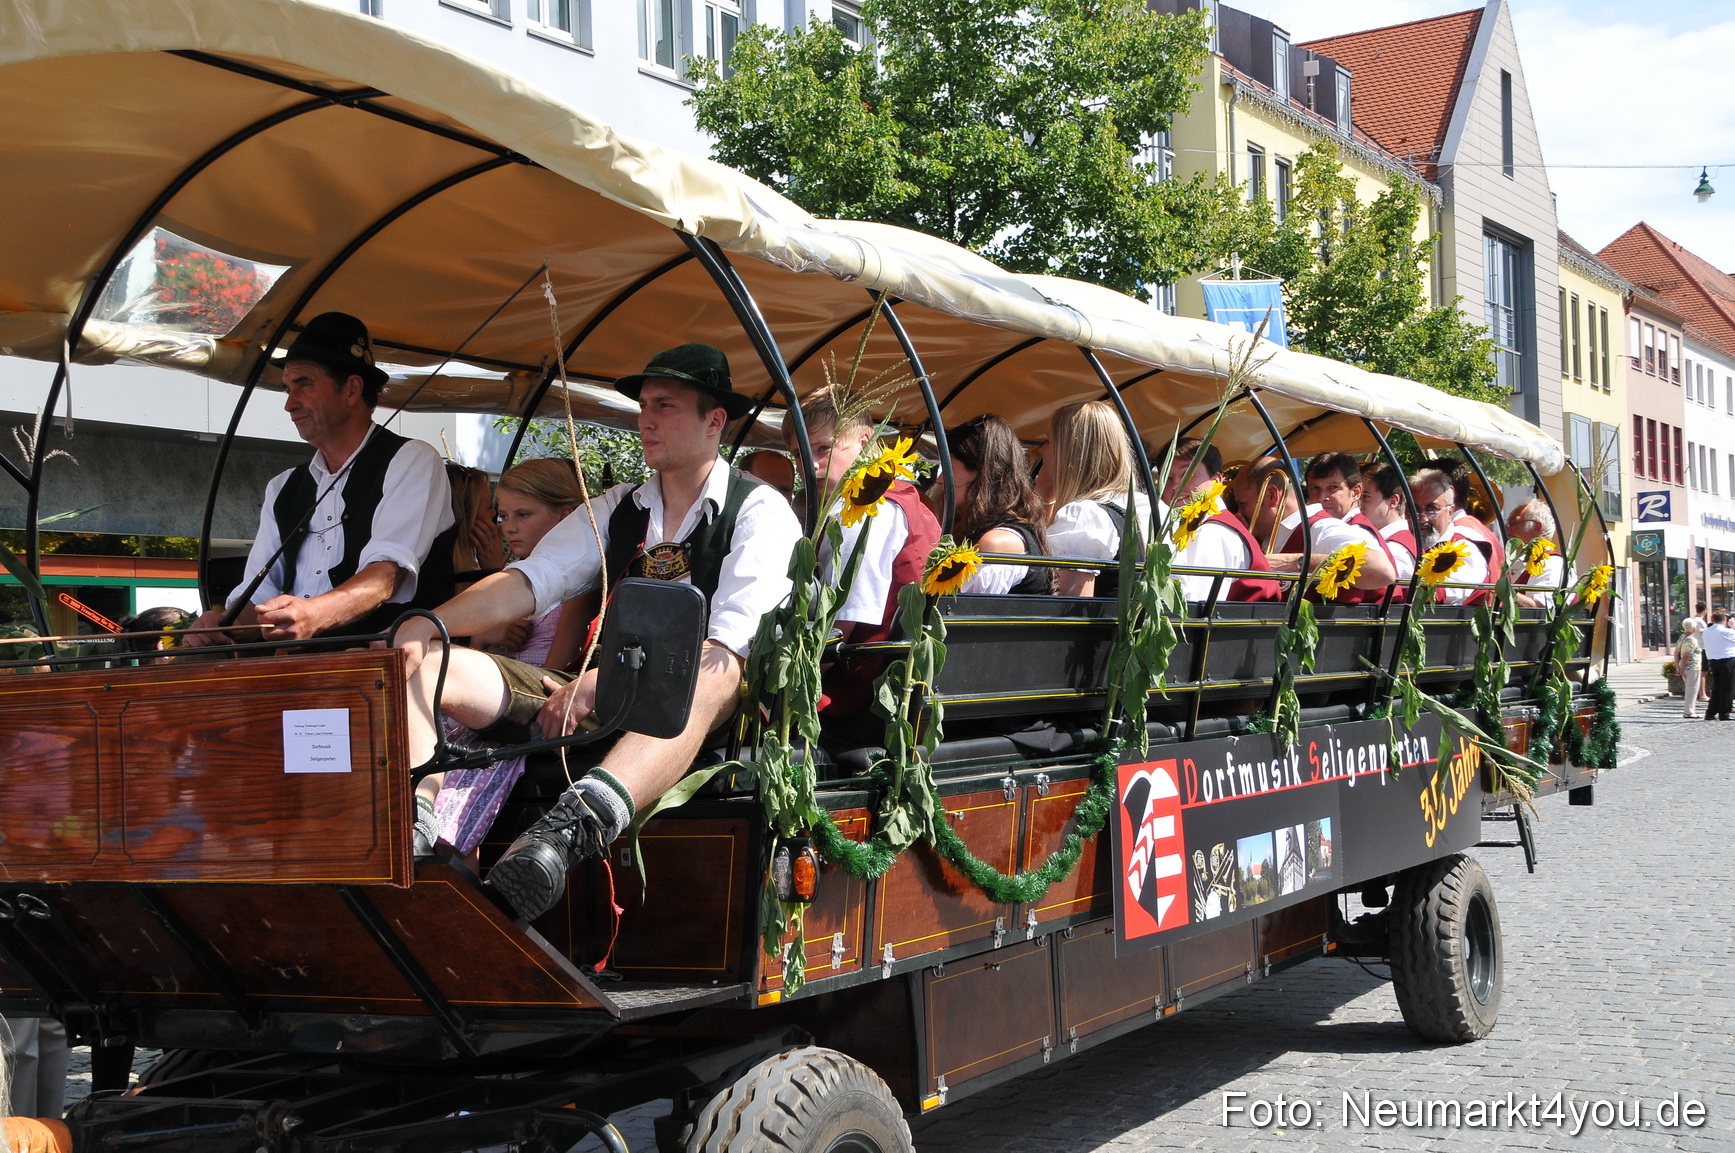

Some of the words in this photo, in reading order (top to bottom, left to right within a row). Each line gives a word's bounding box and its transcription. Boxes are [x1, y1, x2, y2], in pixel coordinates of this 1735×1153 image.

[1183, 743, 1302, 805] Dorfmusik
[1308, 733, 1430, 787] Seligenprten
[1420, 769, 1447, 848] 35
